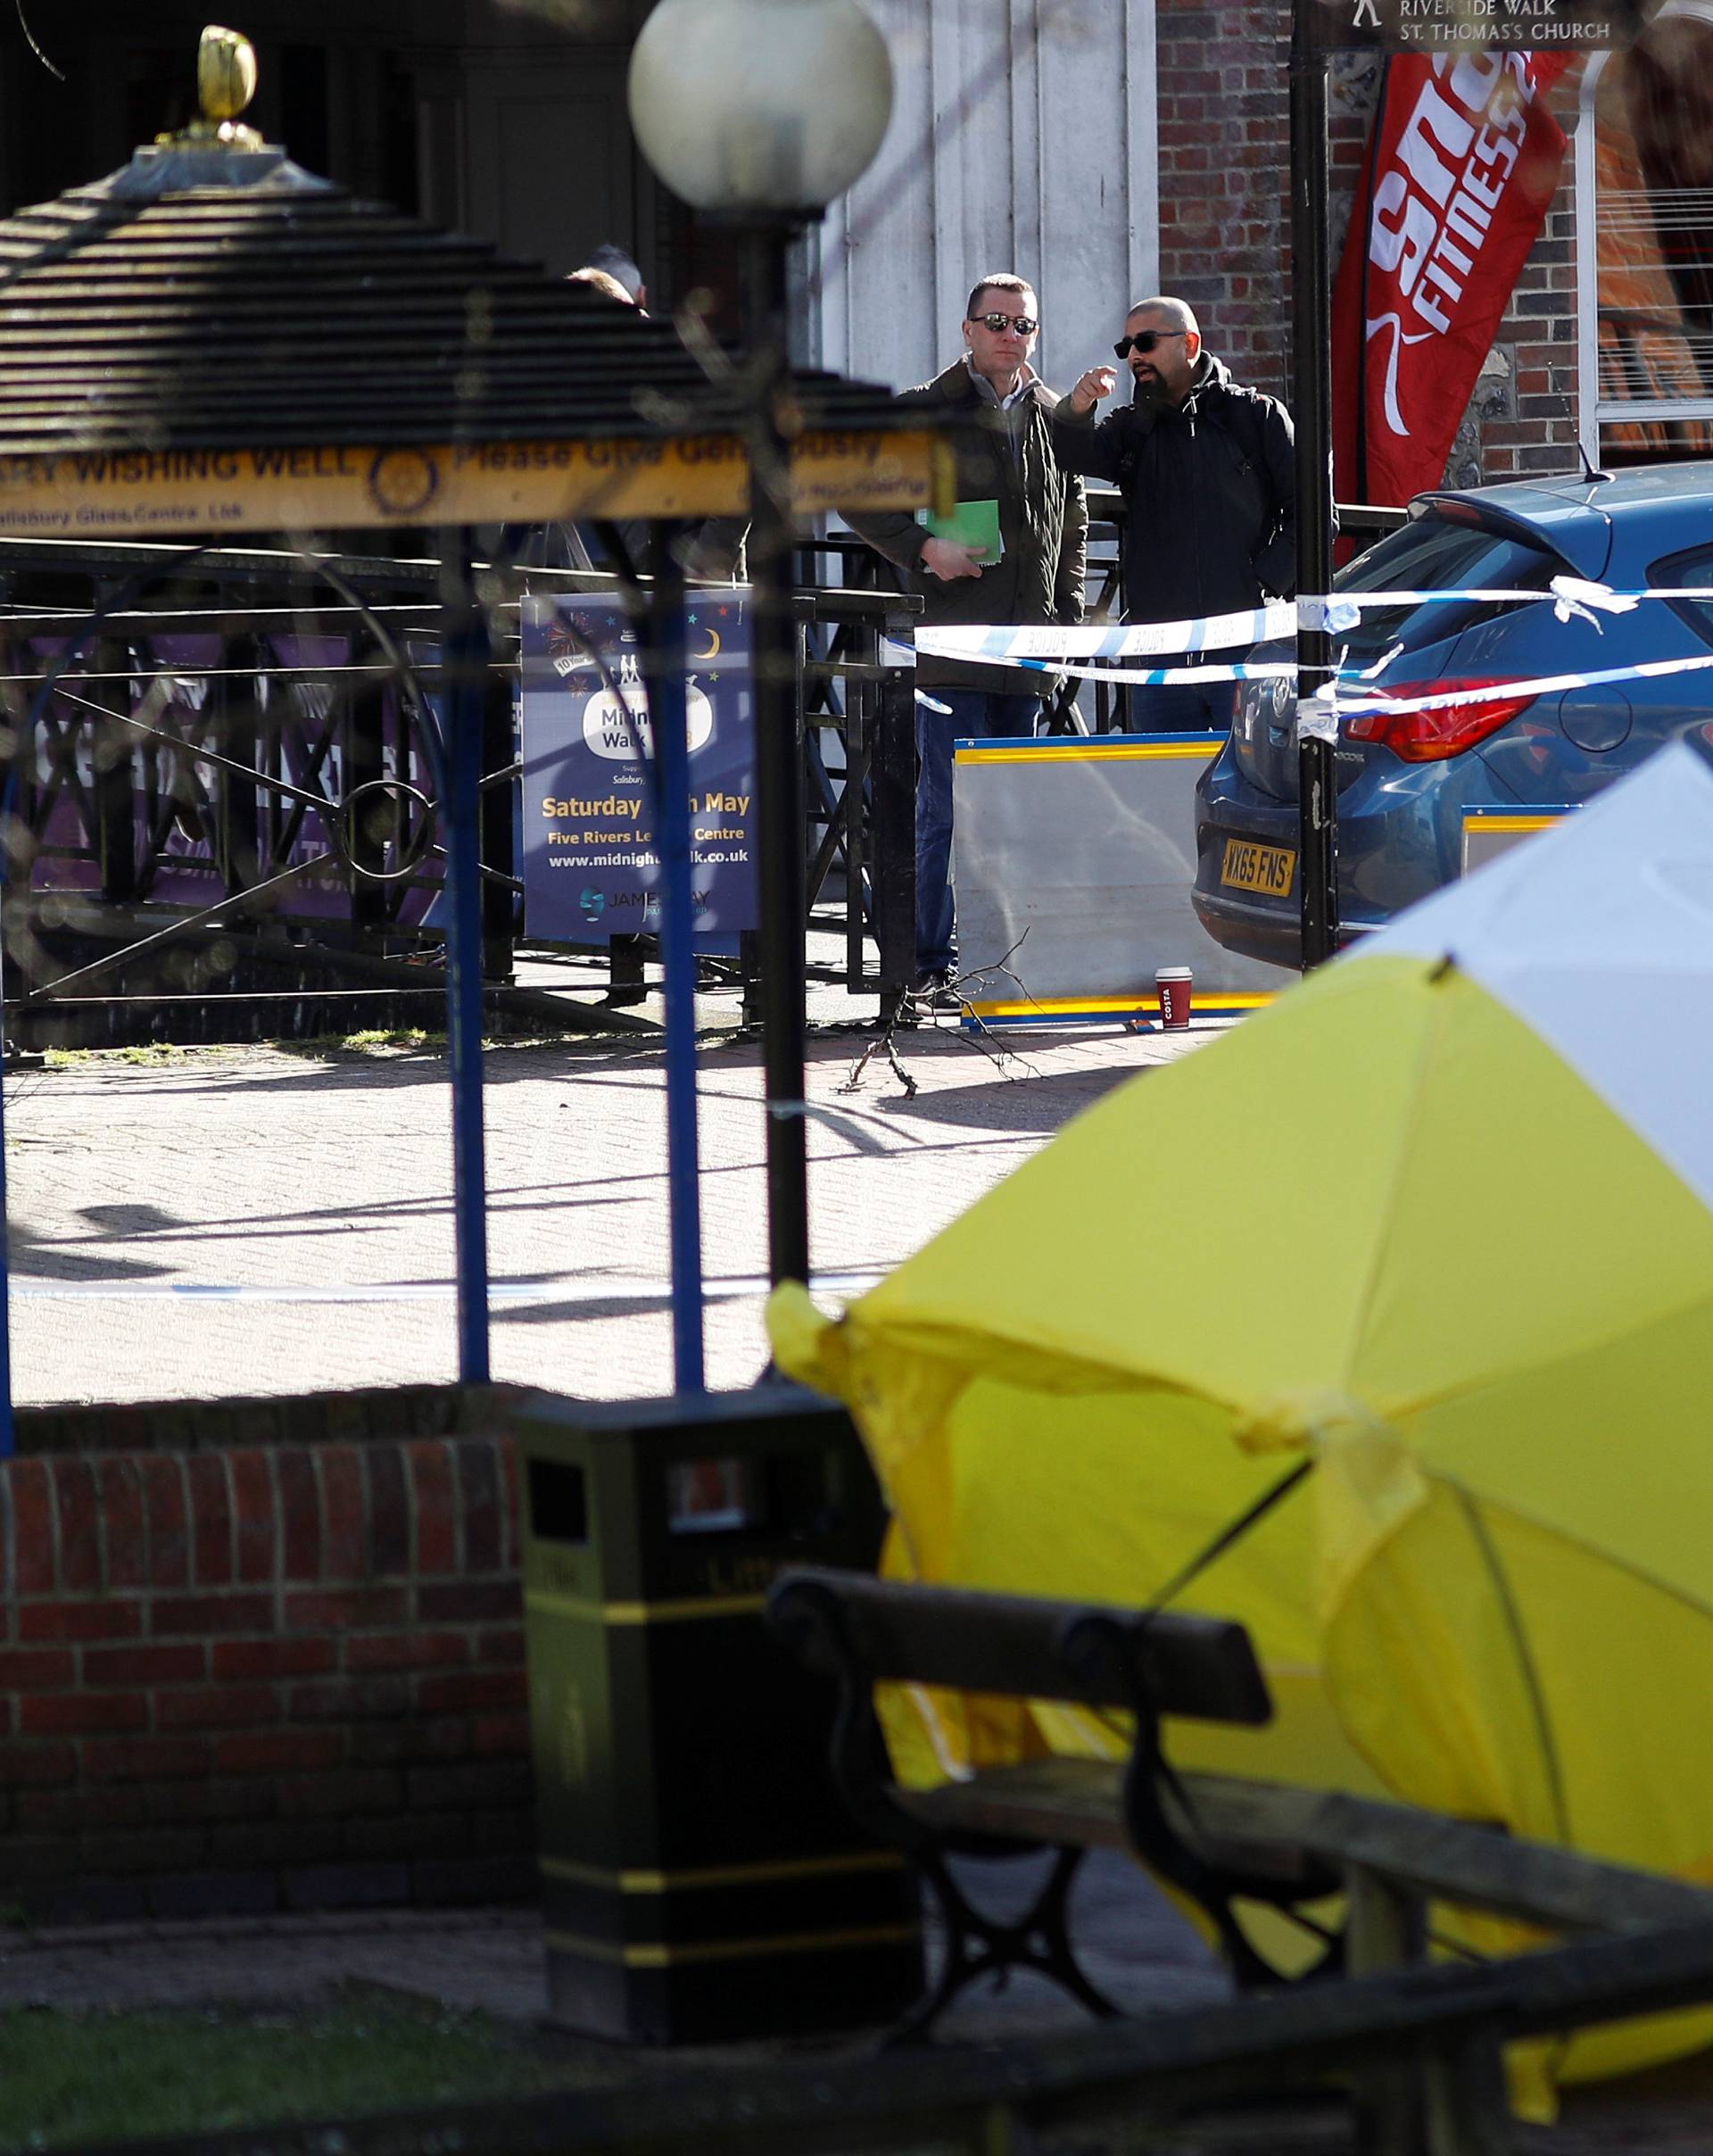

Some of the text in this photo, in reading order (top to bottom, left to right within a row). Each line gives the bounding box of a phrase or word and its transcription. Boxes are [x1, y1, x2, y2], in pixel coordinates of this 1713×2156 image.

[1400, 0, 1556, 16] RIVERIDE WALK
[1400, 23, 1610, 41] ST. THOMAS'S CHURCH
[1411, 89, 1527, 336] FITNESS
[75, 448, 240, 483] WISHING
[252, 446, 360, 478] WELL
[558, 658, 571, 671] 10
[542, 795, 642, 819] Saturday
[705, 792, 750, 817] May
[548, 832, 580, 845] Five
[583, 831, 632, 843] Rivers
[694, 827, 745, 841] Centre
[549, 849, 749, 868] www.midnighlk.co.uk
[1226, 844, 1288, 890] WX65 FNS
[608, 891, 658, 908] JAME
[1163, 988, 1172, 1020] COSTA
